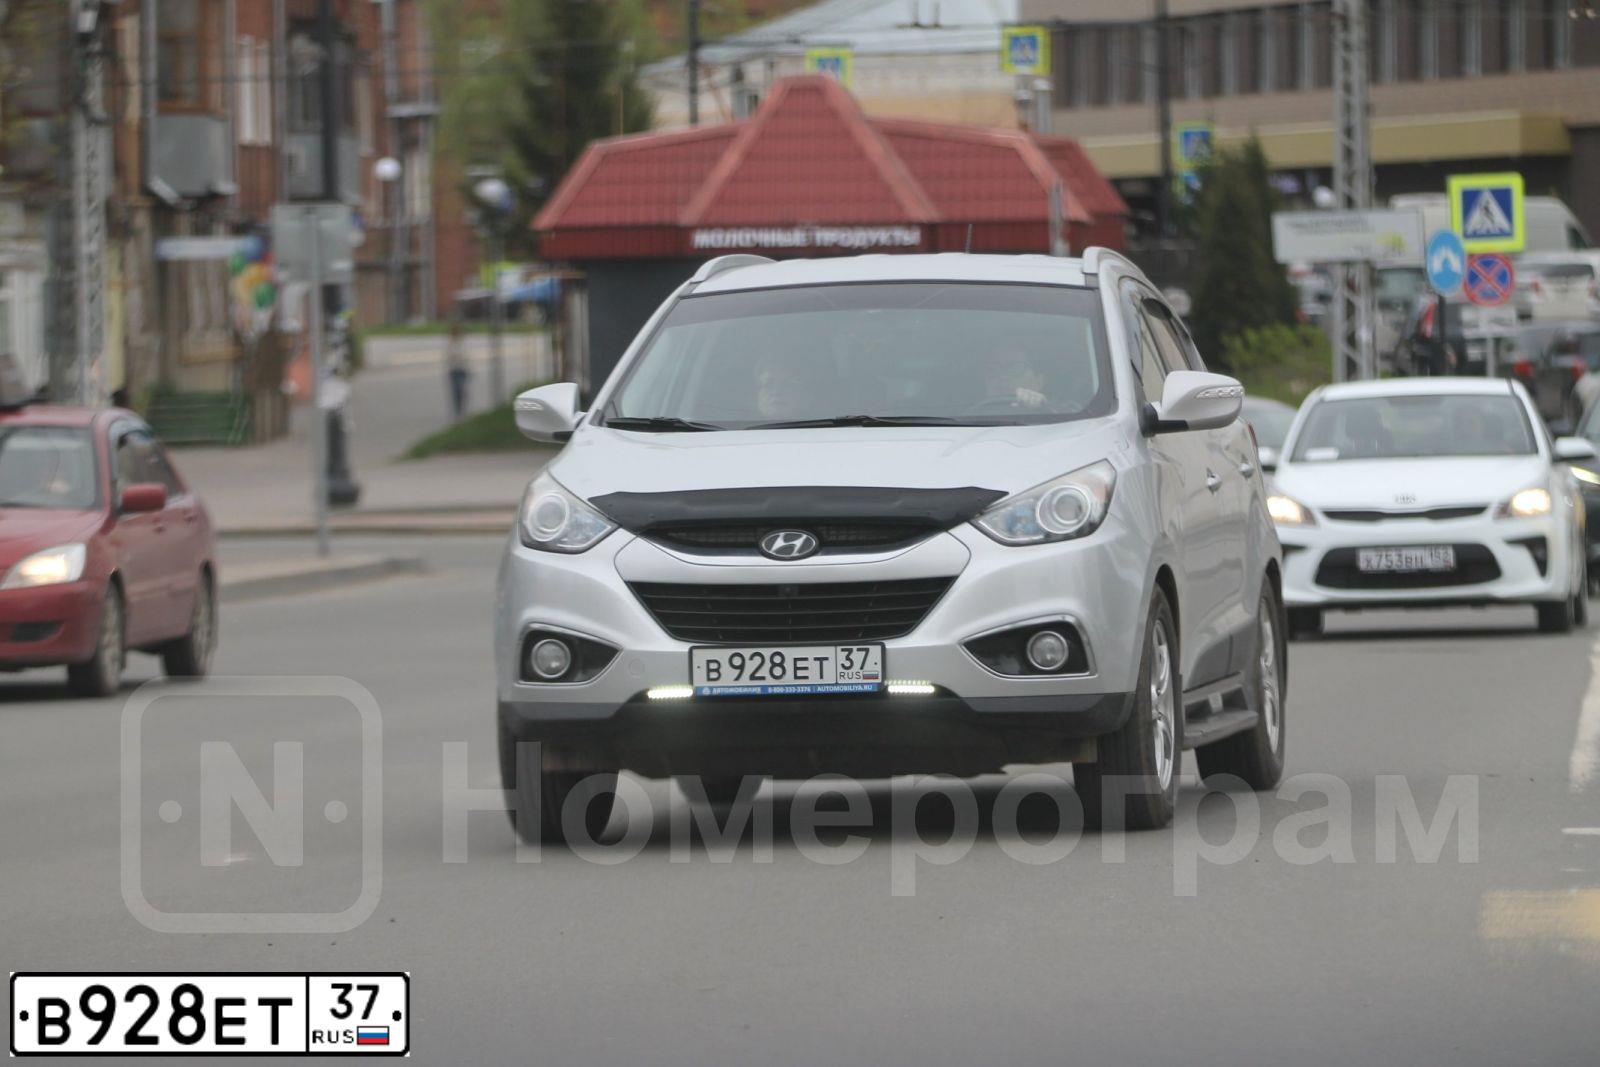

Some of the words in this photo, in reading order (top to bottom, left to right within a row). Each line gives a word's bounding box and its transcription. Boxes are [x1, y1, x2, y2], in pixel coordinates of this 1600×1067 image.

[693, 227, 811, 248] МОЛОЧНЫЕ
[815, 225, 922, 249] ПРОДУКТЫ
[705, 651, 830, 682] В928ЕТ
[840, 647, 870, 671] 37
[839, 671, 862, 680] RUS
[817, 684, 873, 692] AUTOMOBILIYA.RU
